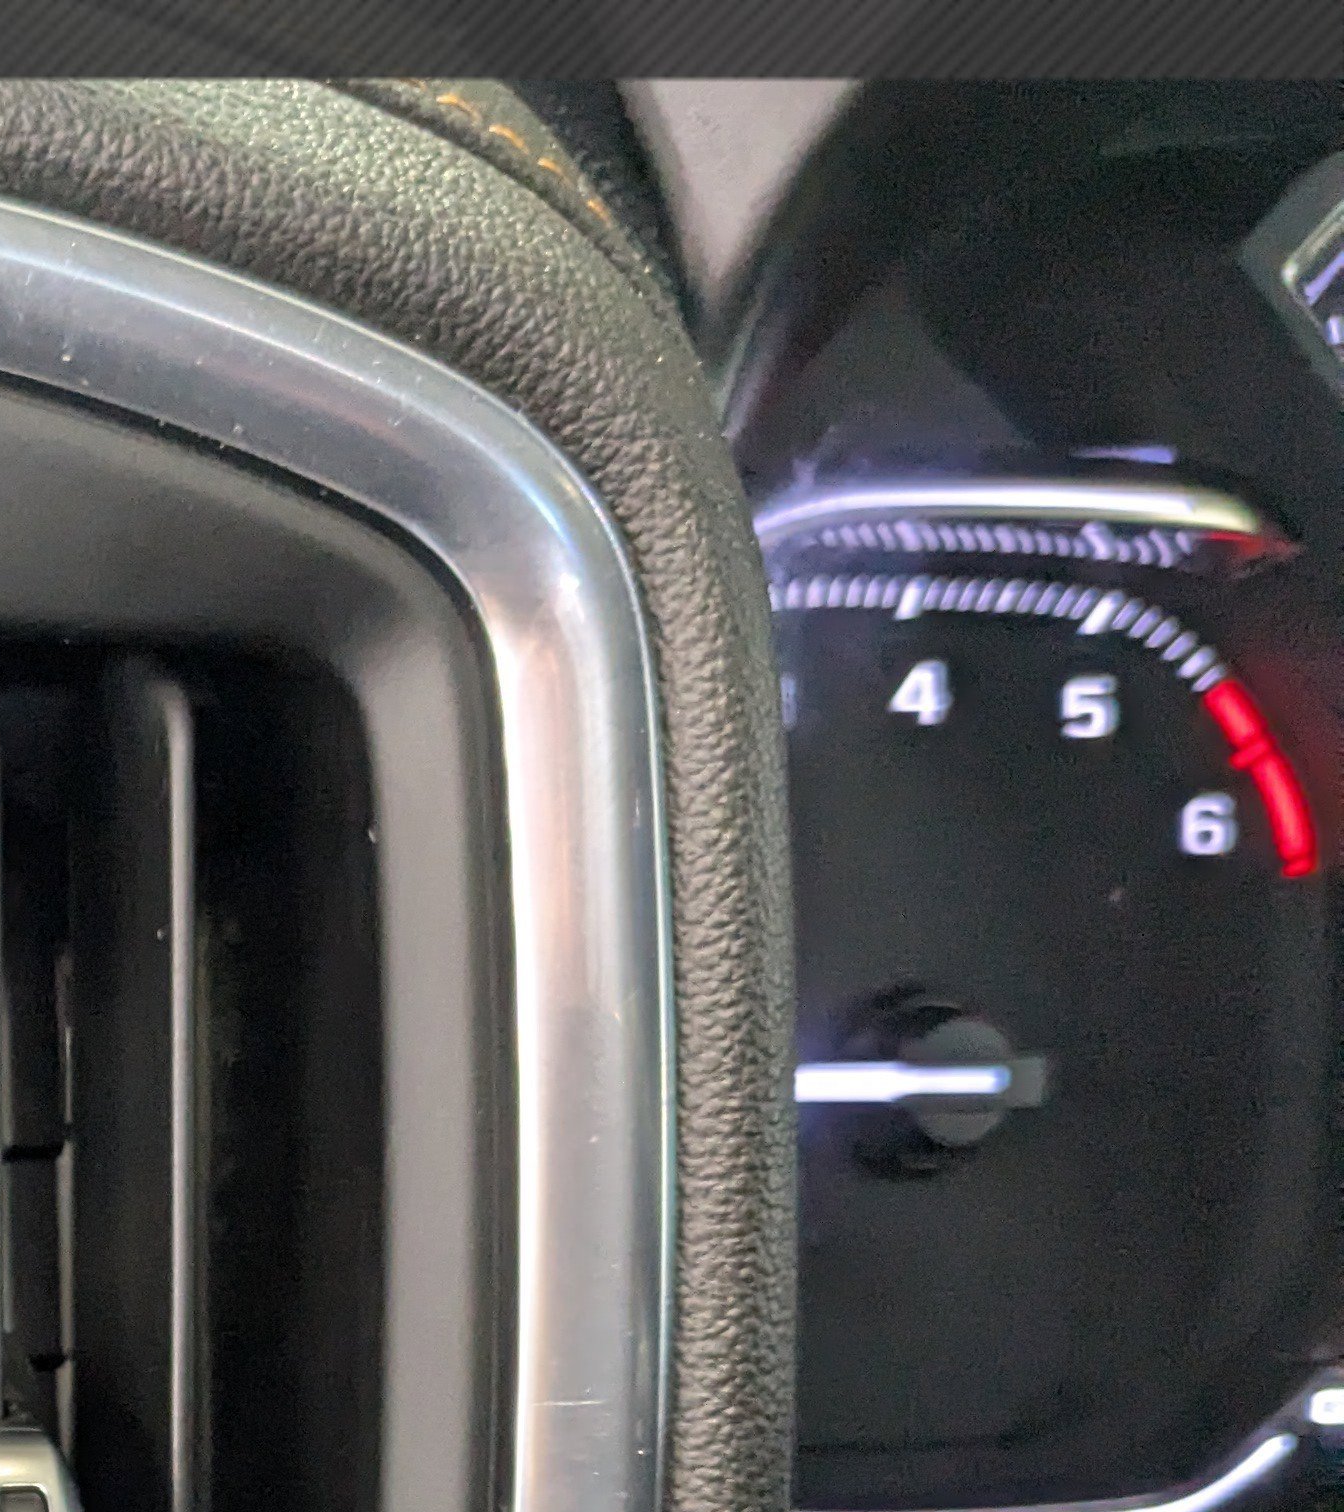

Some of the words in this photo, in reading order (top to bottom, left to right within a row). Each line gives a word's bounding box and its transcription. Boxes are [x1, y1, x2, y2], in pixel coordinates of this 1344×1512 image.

[889, 659, 953, 726] 4
[1060, 674, 1118, 740] 5
[1179, 792, 1237, 857] 6
